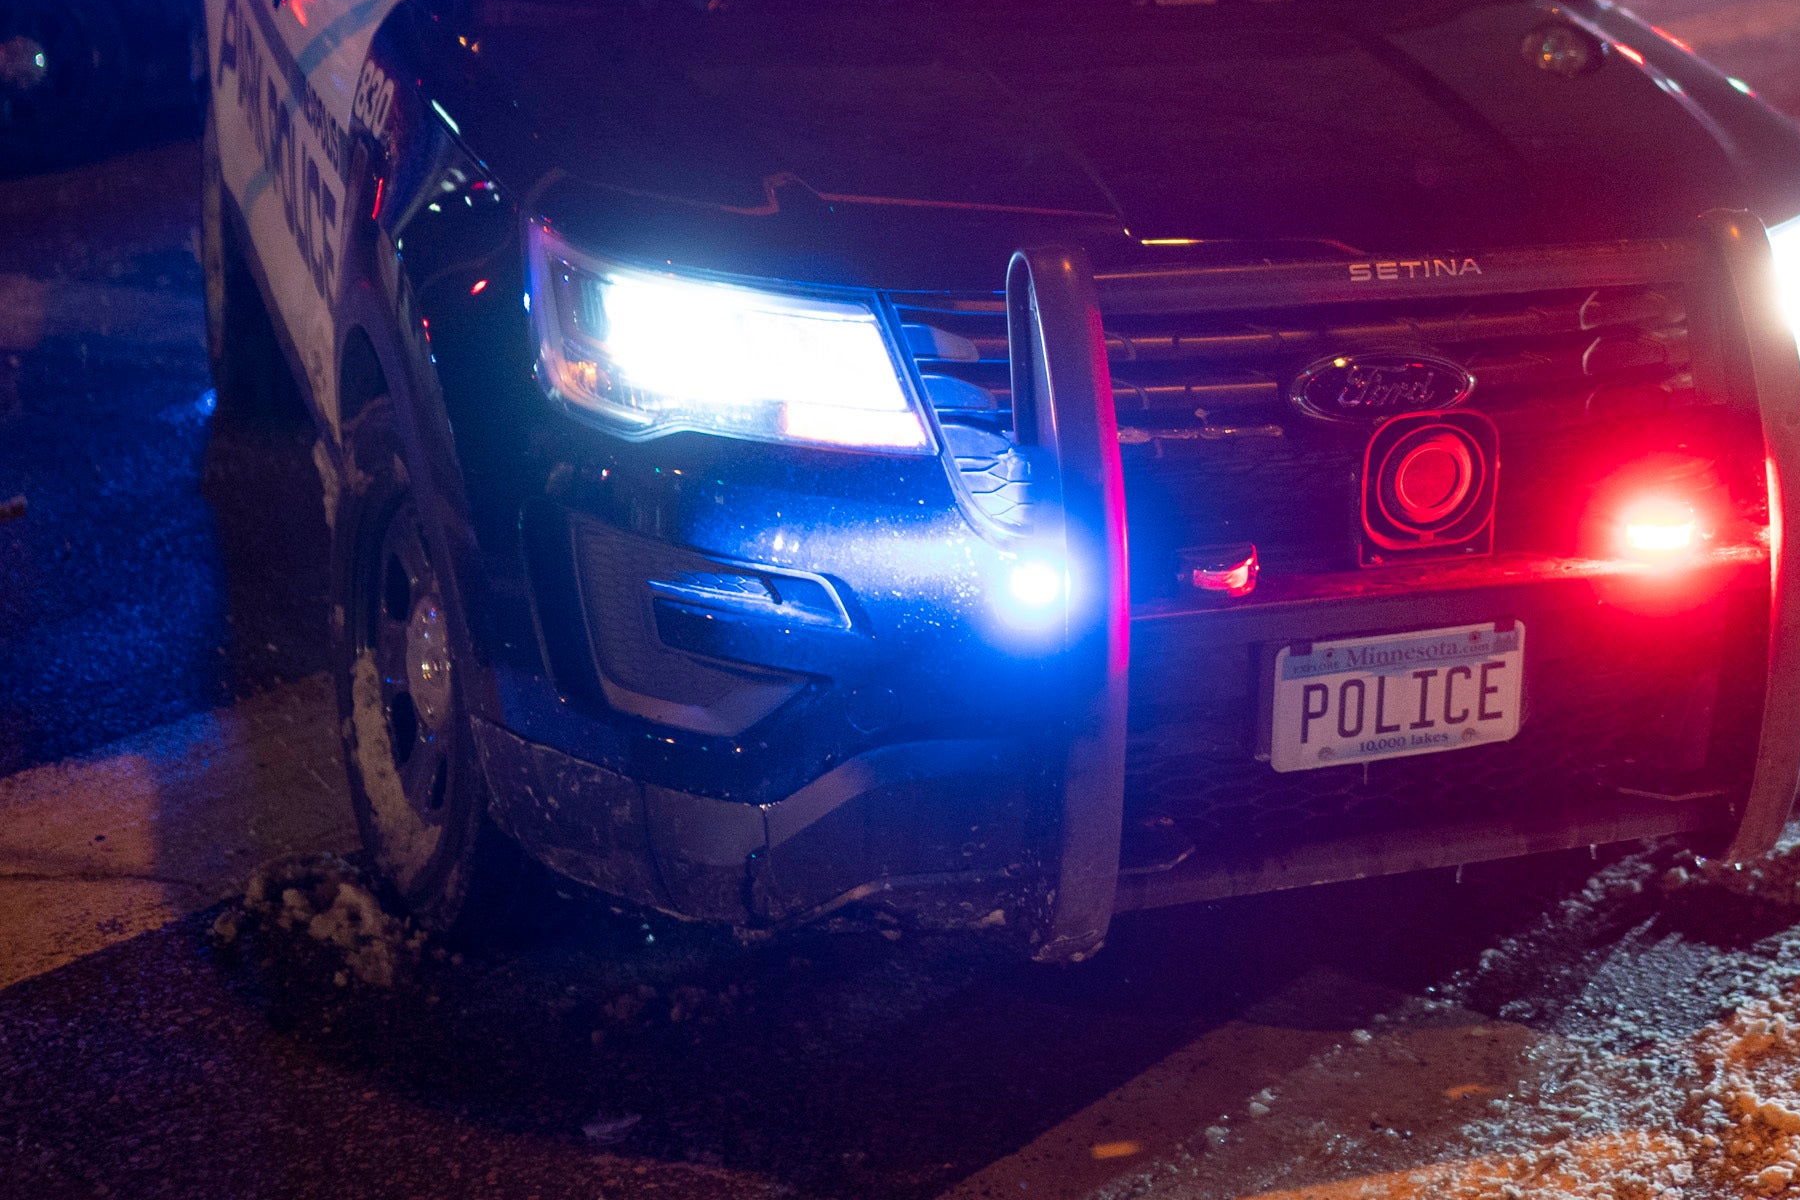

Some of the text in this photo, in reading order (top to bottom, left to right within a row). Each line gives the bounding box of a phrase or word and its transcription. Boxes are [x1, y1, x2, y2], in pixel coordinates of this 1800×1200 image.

[353, 58, 394, 139] 830
[265, 71, 337, 299] POLICE
[1350, 258, 1482, 282] SETINA
[1338, 365, 1435, 408] Ford
[1300, 661, 1507, 745] POLICE
[1359, 731, 1449, 753] 10,000 lakes
